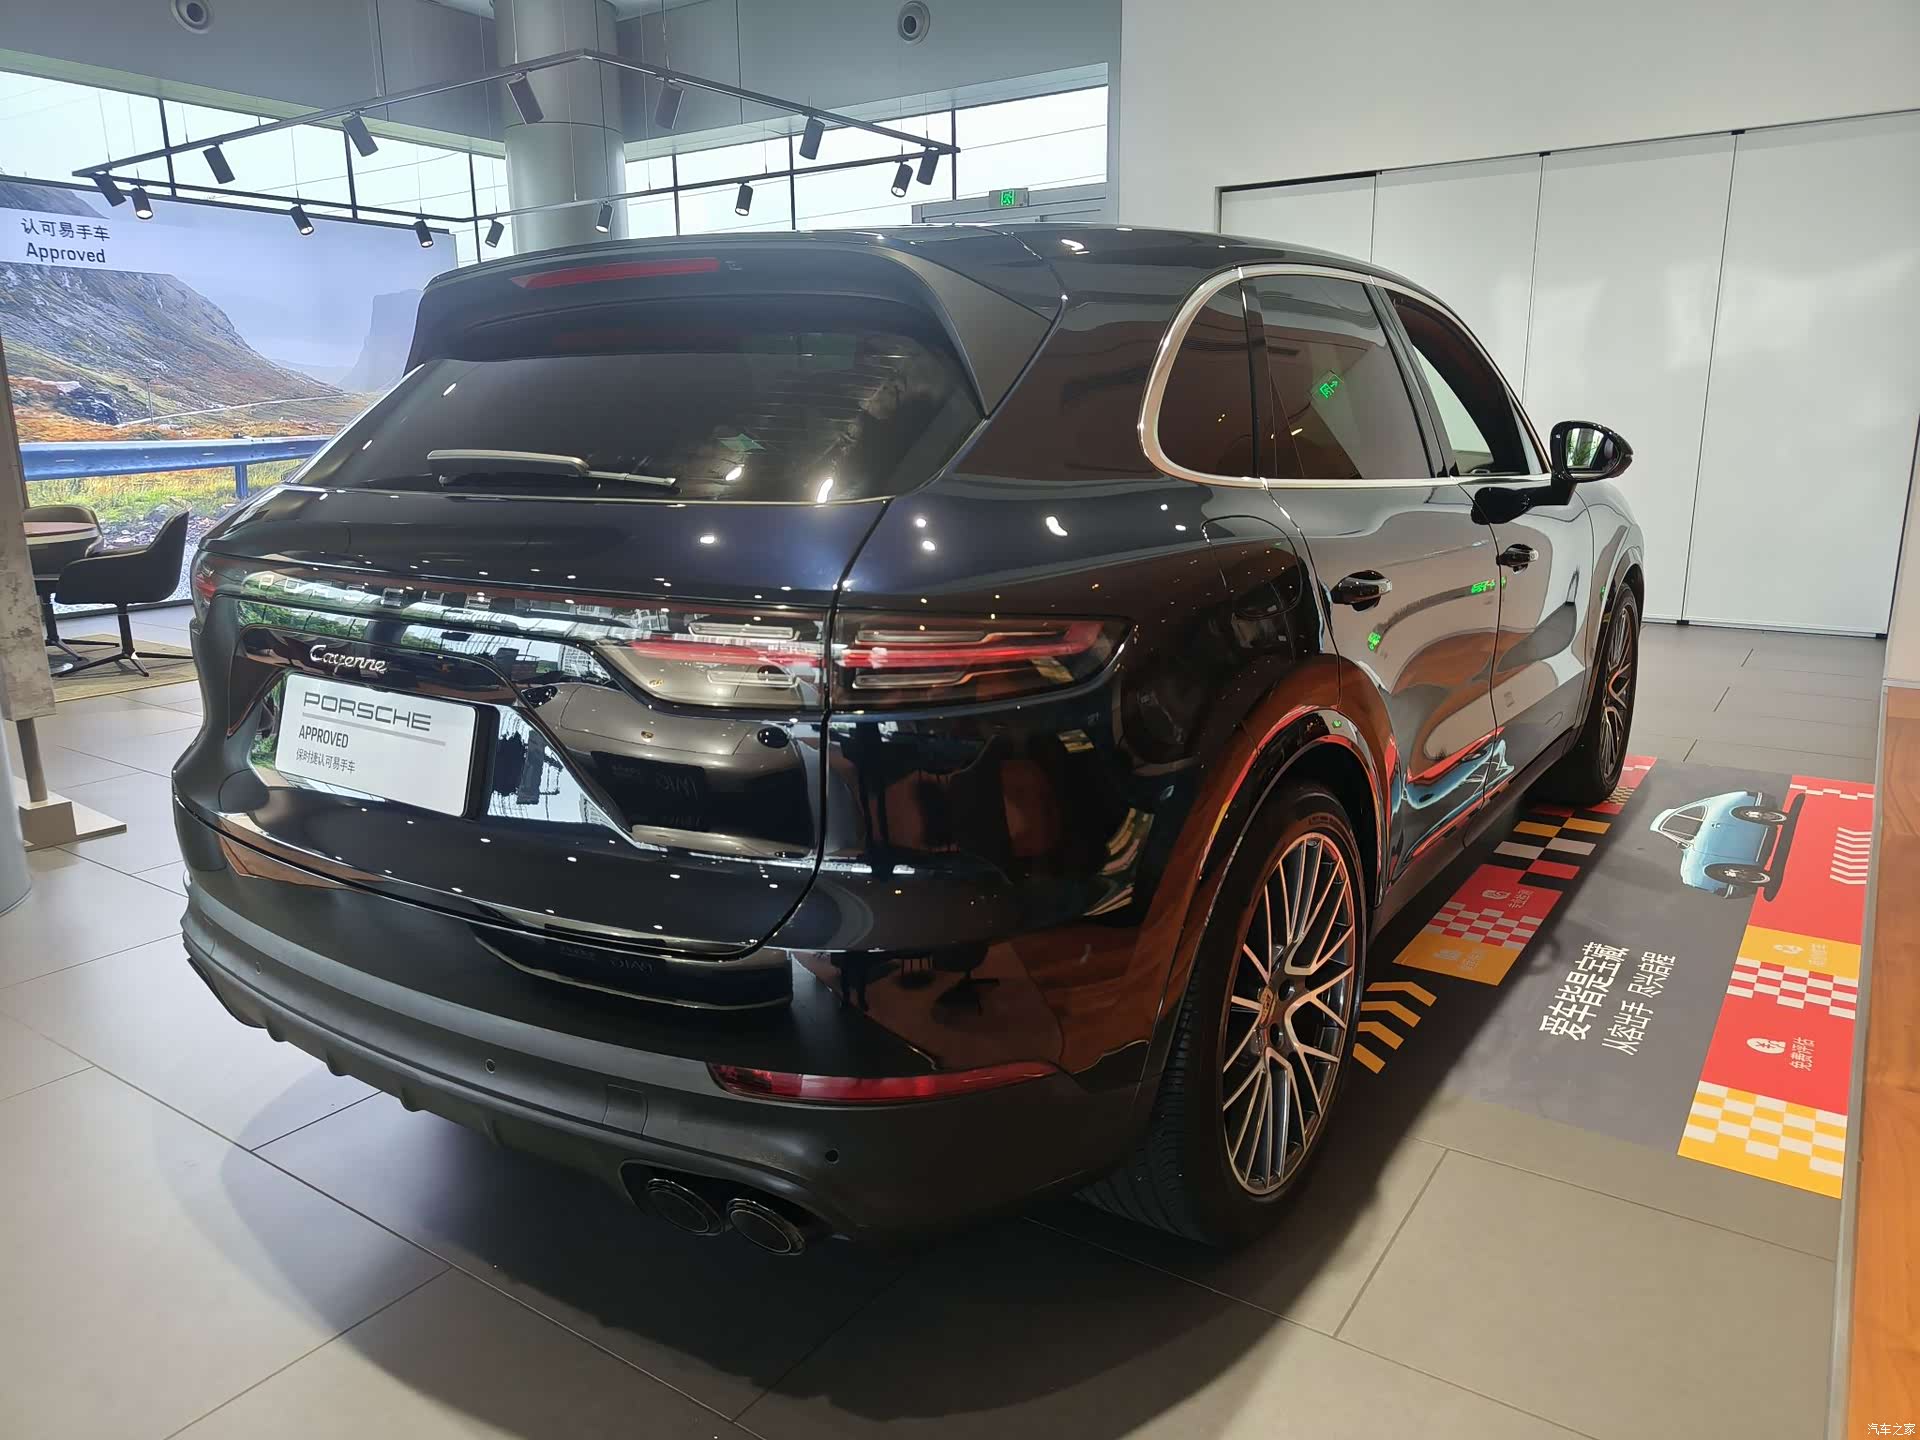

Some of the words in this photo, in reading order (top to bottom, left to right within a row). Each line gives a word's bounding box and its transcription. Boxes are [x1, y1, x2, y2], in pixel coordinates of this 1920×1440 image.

[21, 218, 110, 241] 认可易手车
[26, 242, 106, 263] Approved
[310, 644, 387, 676] Cayenne
[304, 691, 432, 732] PORSCHE
[298, 725, 349, 748] APPROVED
[296, 748, 356, 774] 保时捷认可易手车
[1627, 951, 1676, 998] 尽兴启程
[1539, 942, 1630, 1041] 爱车皆是宝藏
[1602, 1000, 1654, 1055] 从容出手
